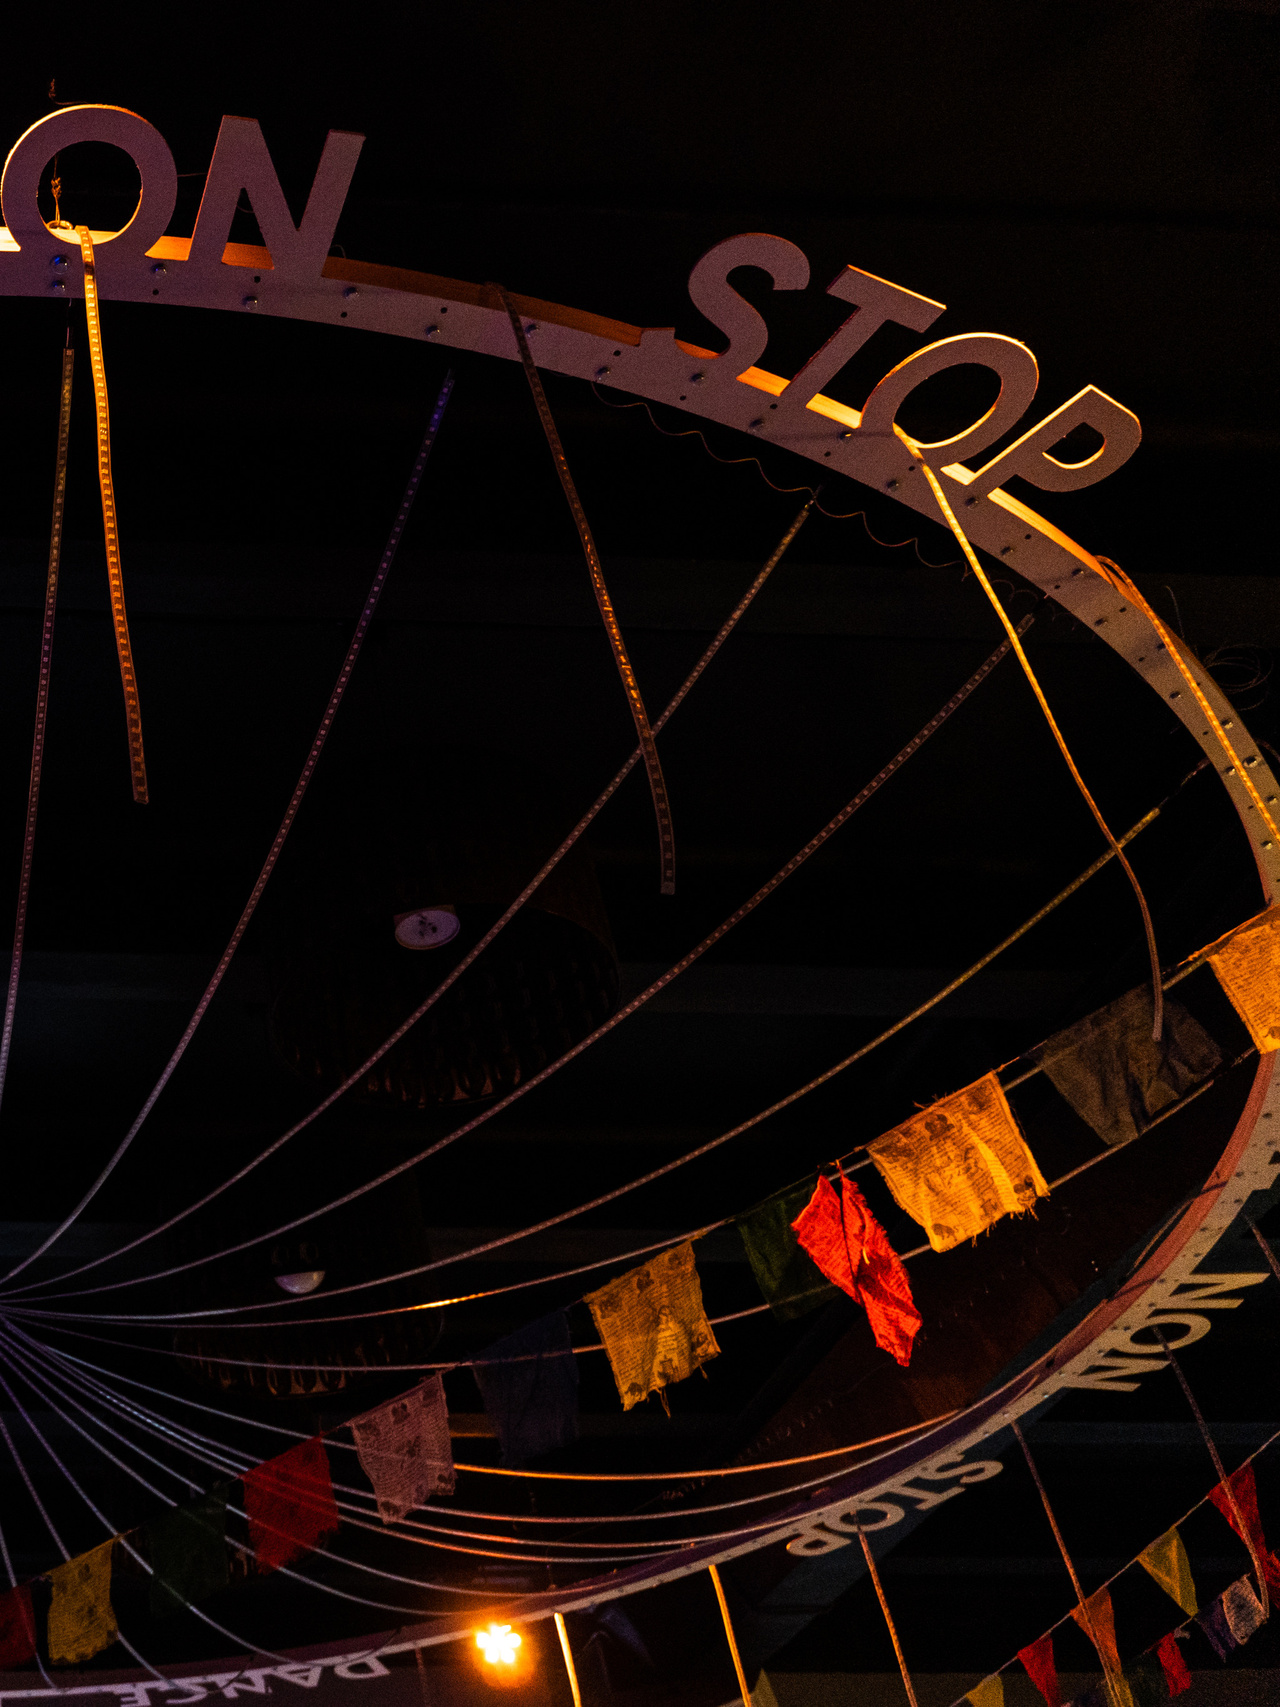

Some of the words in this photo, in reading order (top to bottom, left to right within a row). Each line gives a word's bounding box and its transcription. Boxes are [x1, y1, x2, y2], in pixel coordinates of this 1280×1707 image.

[638, 231, 1143, 498] STOP
[1060, 1272, 1271, 1393] NON
[786, 1448, 1004, 1557] STOP
